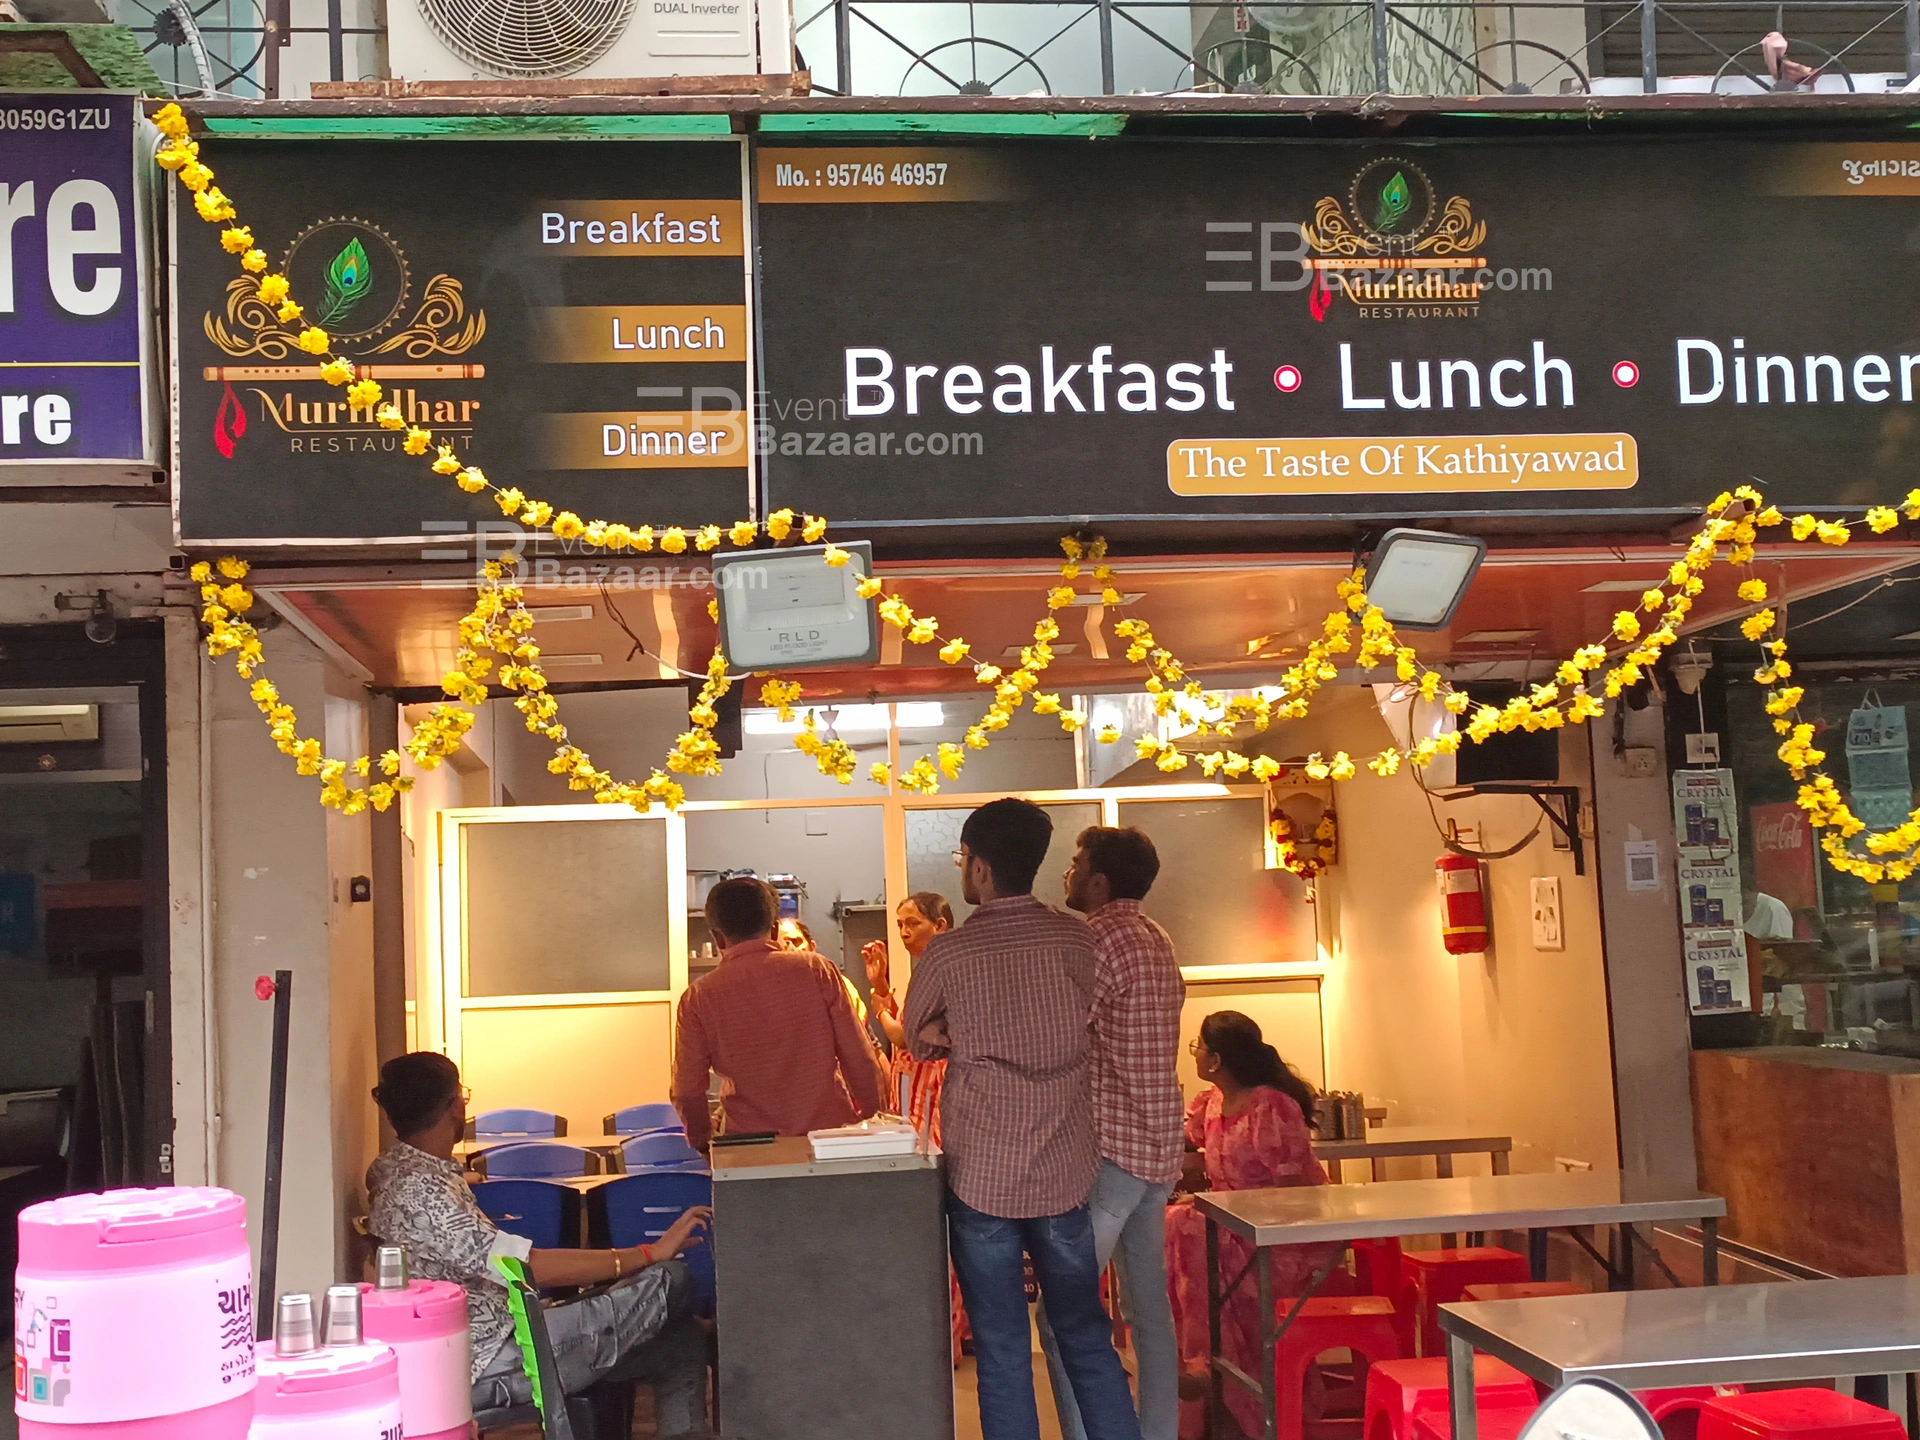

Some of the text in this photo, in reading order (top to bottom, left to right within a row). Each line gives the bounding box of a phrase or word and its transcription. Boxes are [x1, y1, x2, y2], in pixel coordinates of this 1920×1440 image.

[654, 2, 739, 14] DUAL Inverter
[776, 164, 810, 186] Mo.
[827, 163, 885, 187] 95746
[890, 163, 948, 186] 46957
[541, 212, 722, 245] Breakfast
[1329, 273, 1485, 305] Murlidhar
[1359, 306, 1480, 319] RESTAURANT
[612, 317, 726, 349] Lunch
[844, 343, 1236, 417] Breakfast
[1338, 339, 1576, 411] Lunch
[290, 435, 474, 454] RESTAUNT
[602, 424, 727, 457] Dinner
[1178, 441, 1627, 484] The Taste Of Kathiyawad
[1677, 787, 1732, 798] CRYSTAL
[1681, 868, 1736, 879] CRYSTAL
[1687, 947, 1744, 961] CRYSTAL
